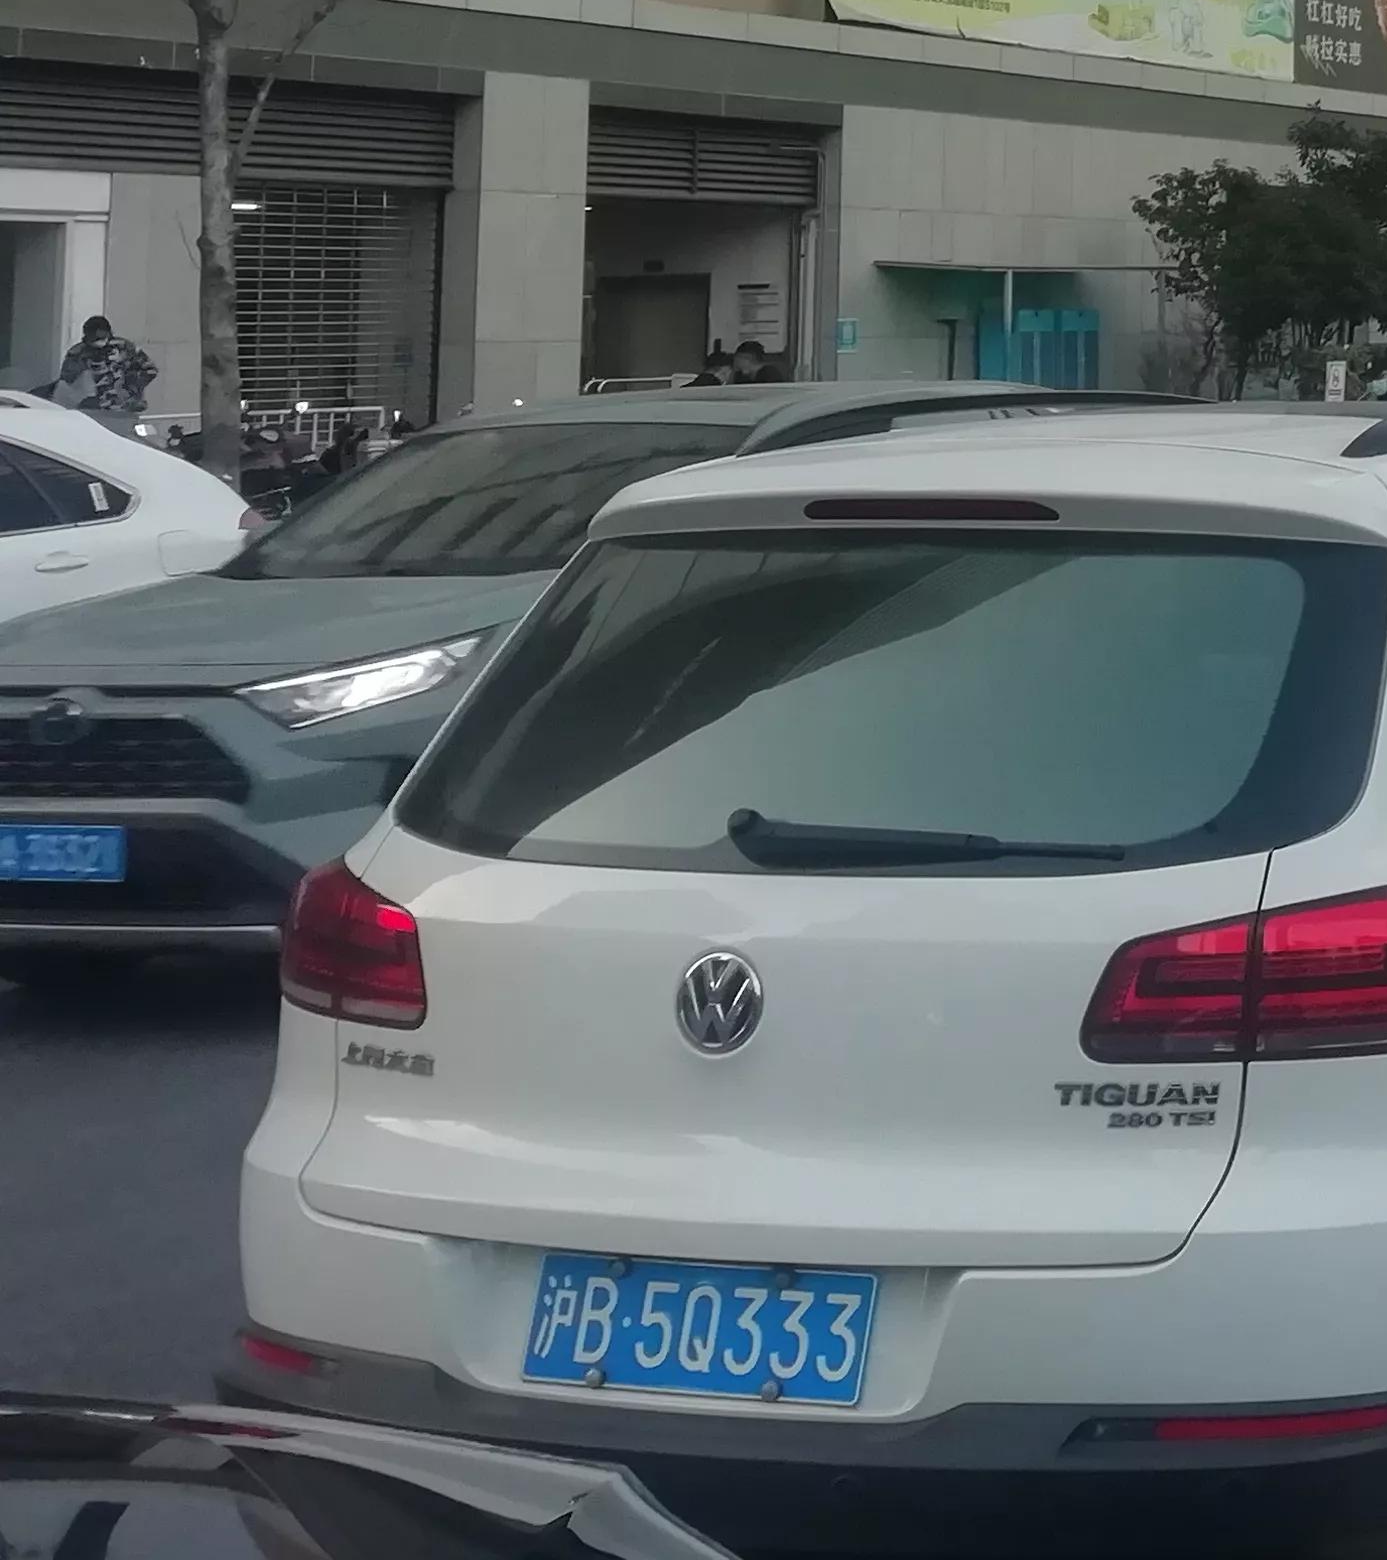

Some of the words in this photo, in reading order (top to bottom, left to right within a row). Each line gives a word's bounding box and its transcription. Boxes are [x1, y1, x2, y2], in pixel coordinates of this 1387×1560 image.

[1054, 1081, 1221, 1107] TIGUAN
[1107, 1112, 1163, 1129] 280
[1169, 1110, 1216, 1127] TSI
